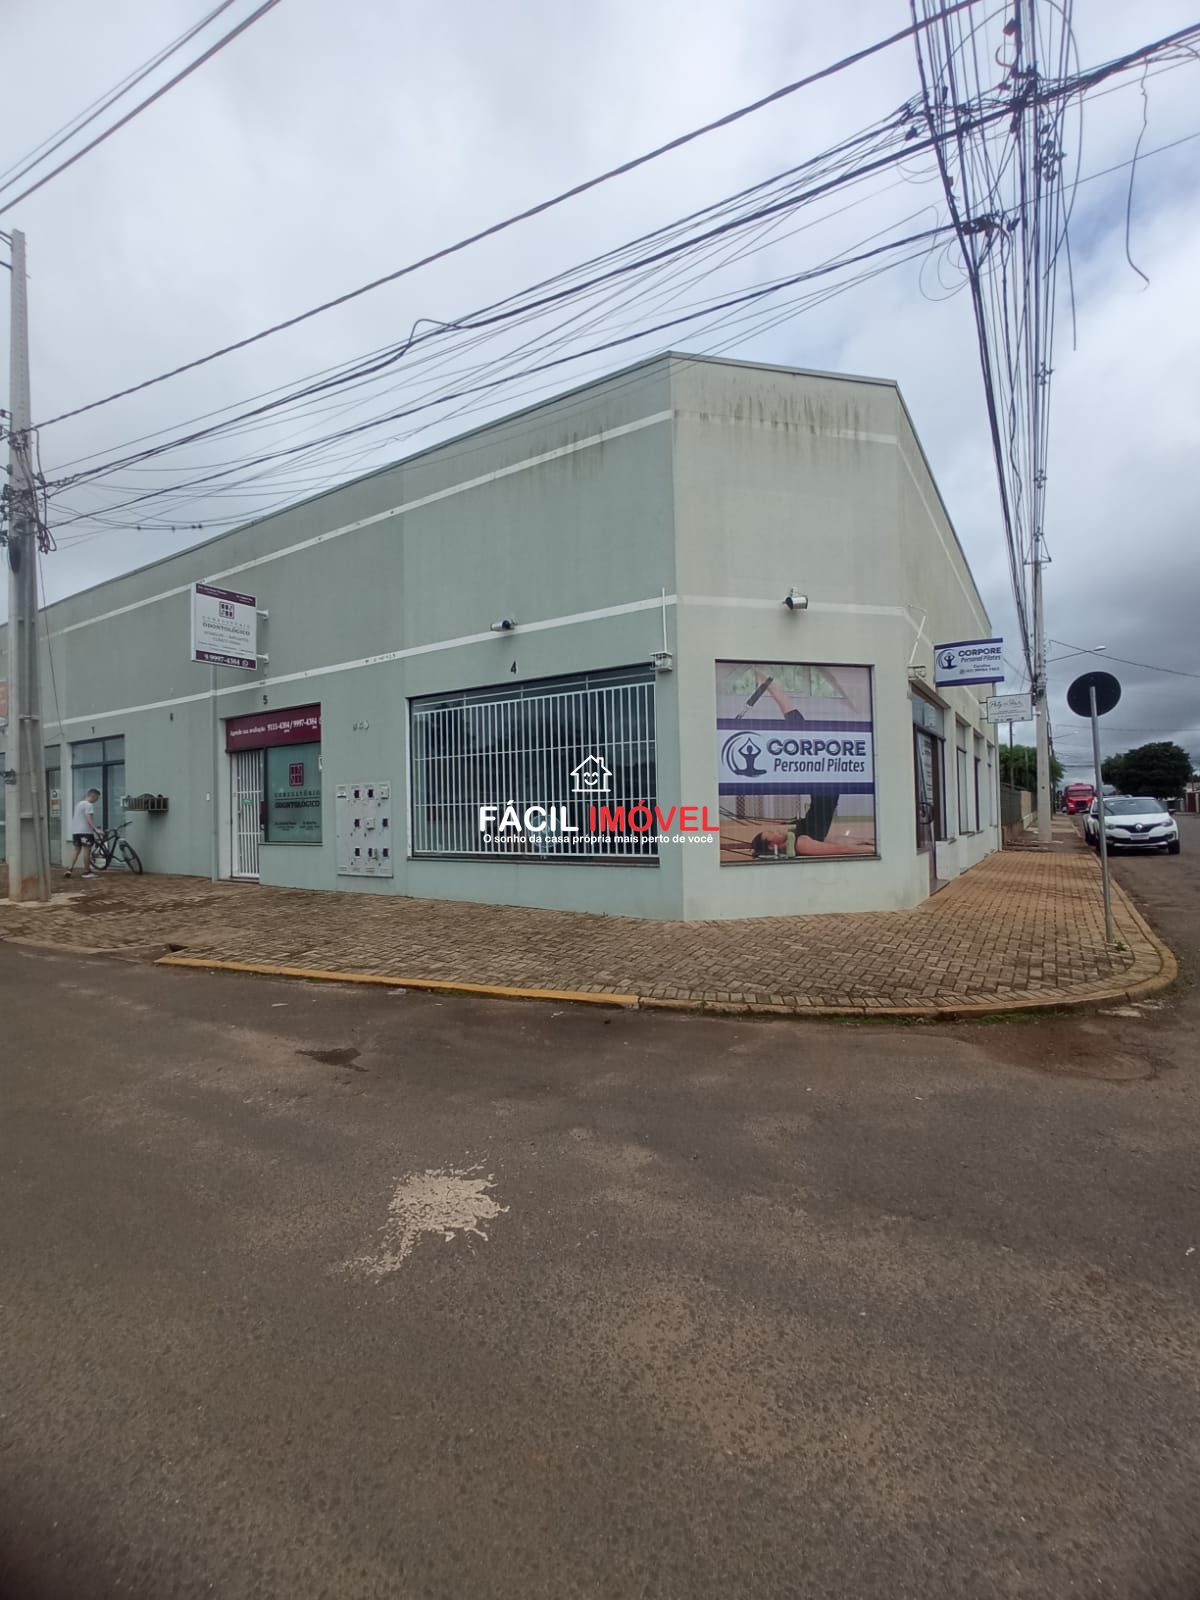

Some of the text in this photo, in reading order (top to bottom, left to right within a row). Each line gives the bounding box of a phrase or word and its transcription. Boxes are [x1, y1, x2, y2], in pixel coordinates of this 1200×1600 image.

[958, 647, 1002, 657] CORPORE
[960, 655, 982, 663] Personal
[510, 660, 517, 675] 4
[262, 695, 268, 705] 5
[767, 738, 866, 756] CORPORE
[773, 758, 865, 772] Personal Pilates
